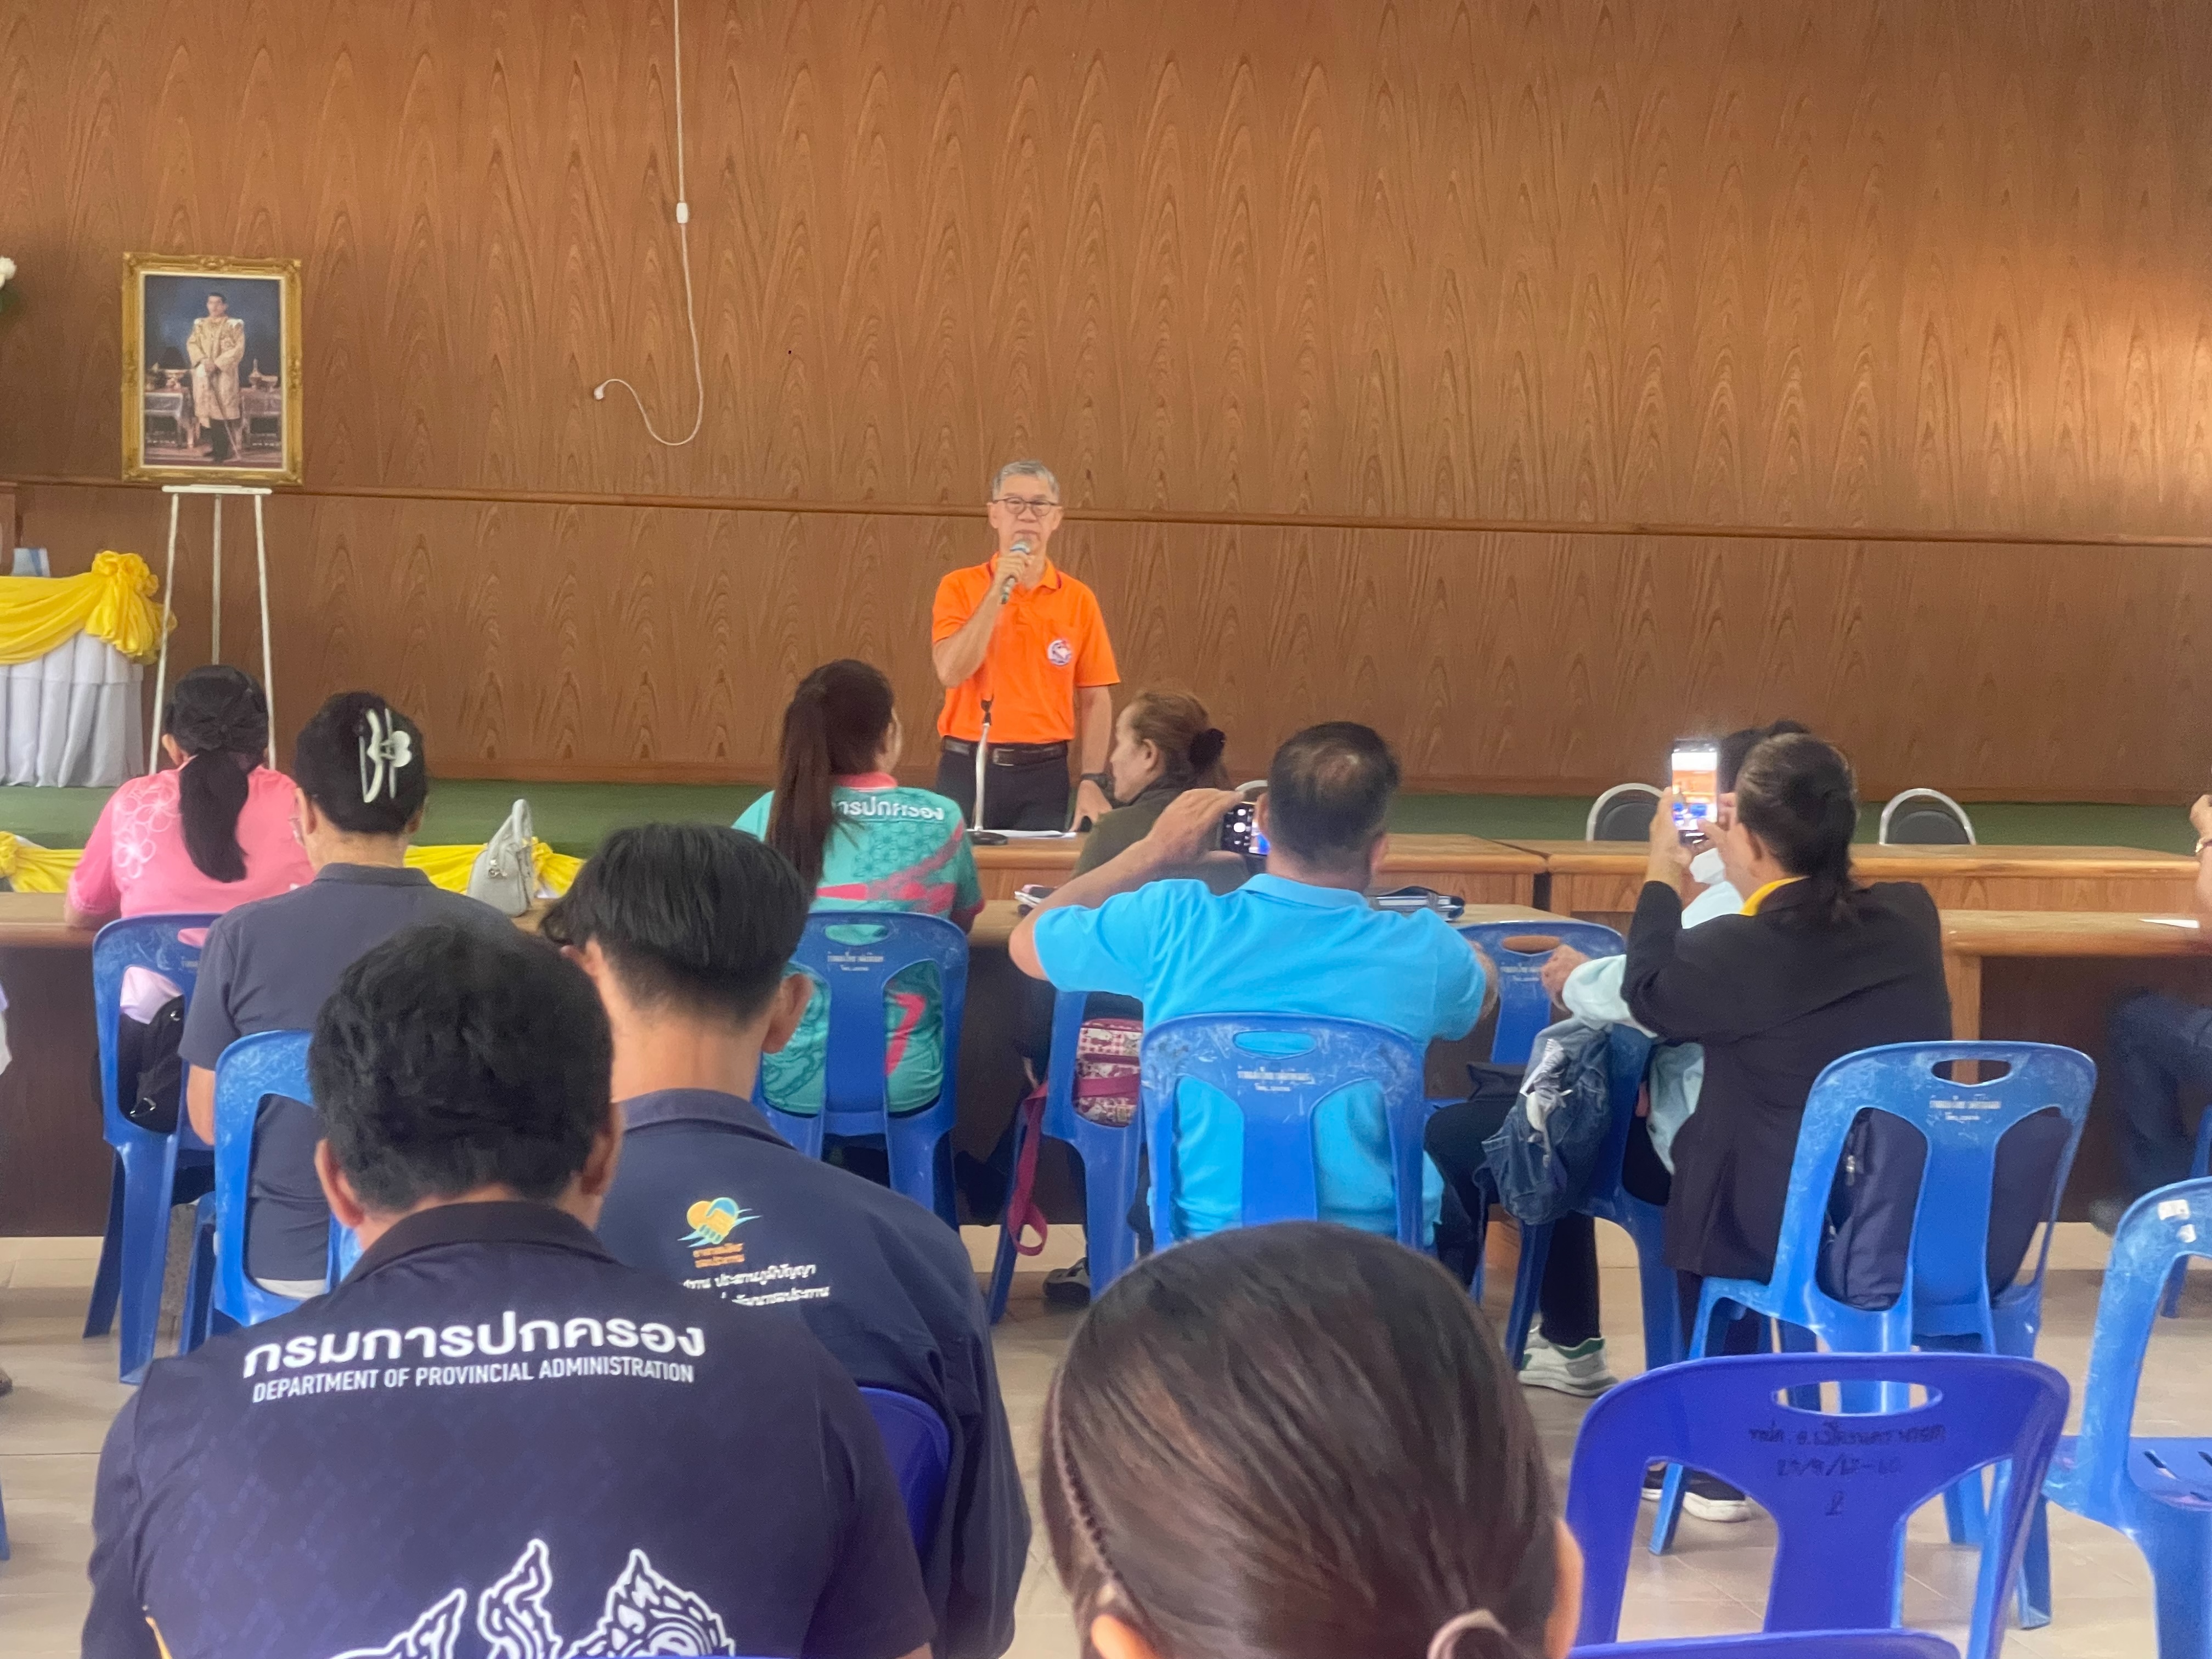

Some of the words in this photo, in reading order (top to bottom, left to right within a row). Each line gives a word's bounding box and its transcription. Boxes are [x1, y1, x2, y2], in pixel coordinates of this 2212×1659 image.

[837, 797, 945, 821] ารปกครอง
[243, 1311, 706, 1378] กรมการปกครอง
[252, 1369, 379, 1403] DEPARTMENT
[384, 1367, 410, 1388] OF
[415, 1362, 534, 1386] PROVINCIAL
[539, 1356, 695, 1384] ADMINISTRATION
